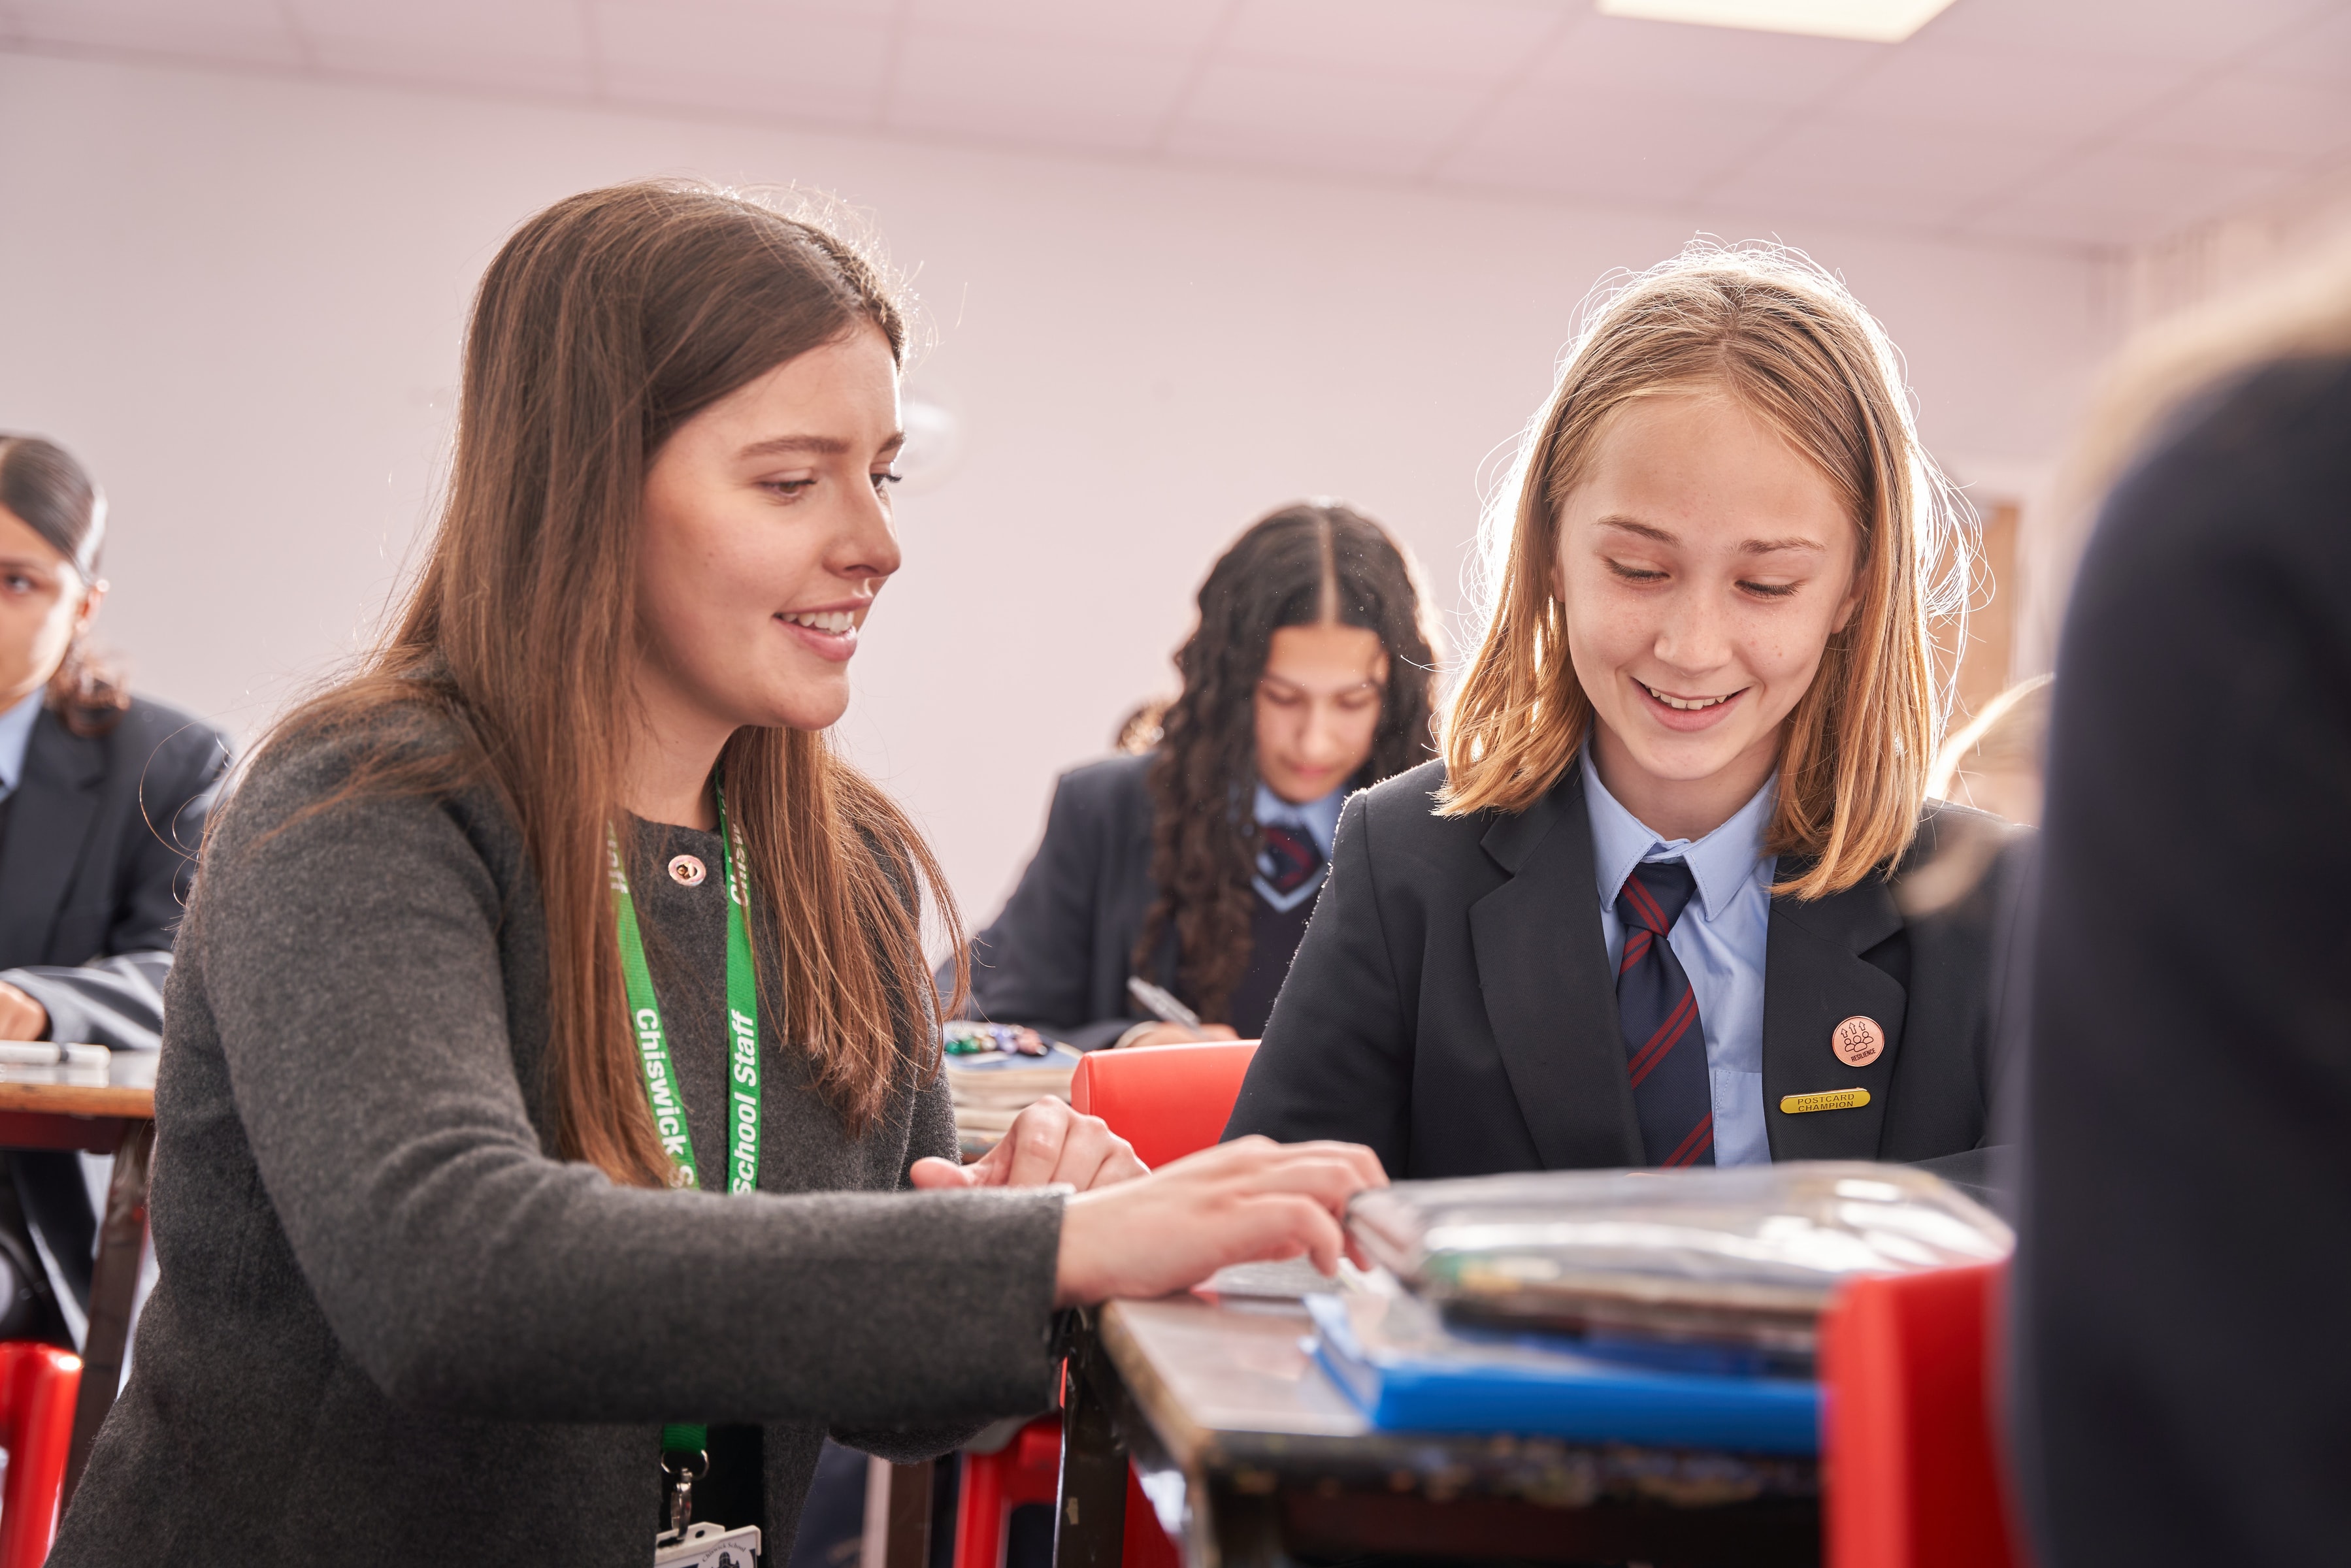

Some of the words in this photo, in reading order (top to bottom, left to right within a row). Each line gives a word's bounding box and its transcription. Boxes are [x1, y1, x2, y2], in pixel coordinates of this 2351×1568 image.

[731, 1008, 757, 1086] Staff
[1850, 1048, 1876, 1062] RESILIENCE
[636, 1008, 687, 1156] Chiswick
[1798, 1094, 1854, 1105] POSTCARD
[1798, 1101, 1854, 1112] CHAMPION
[732, 1092, 757, 1196] School
[702, 1543, 727, 1562] Chiswick
[728, 1543, 746, 1552] School
